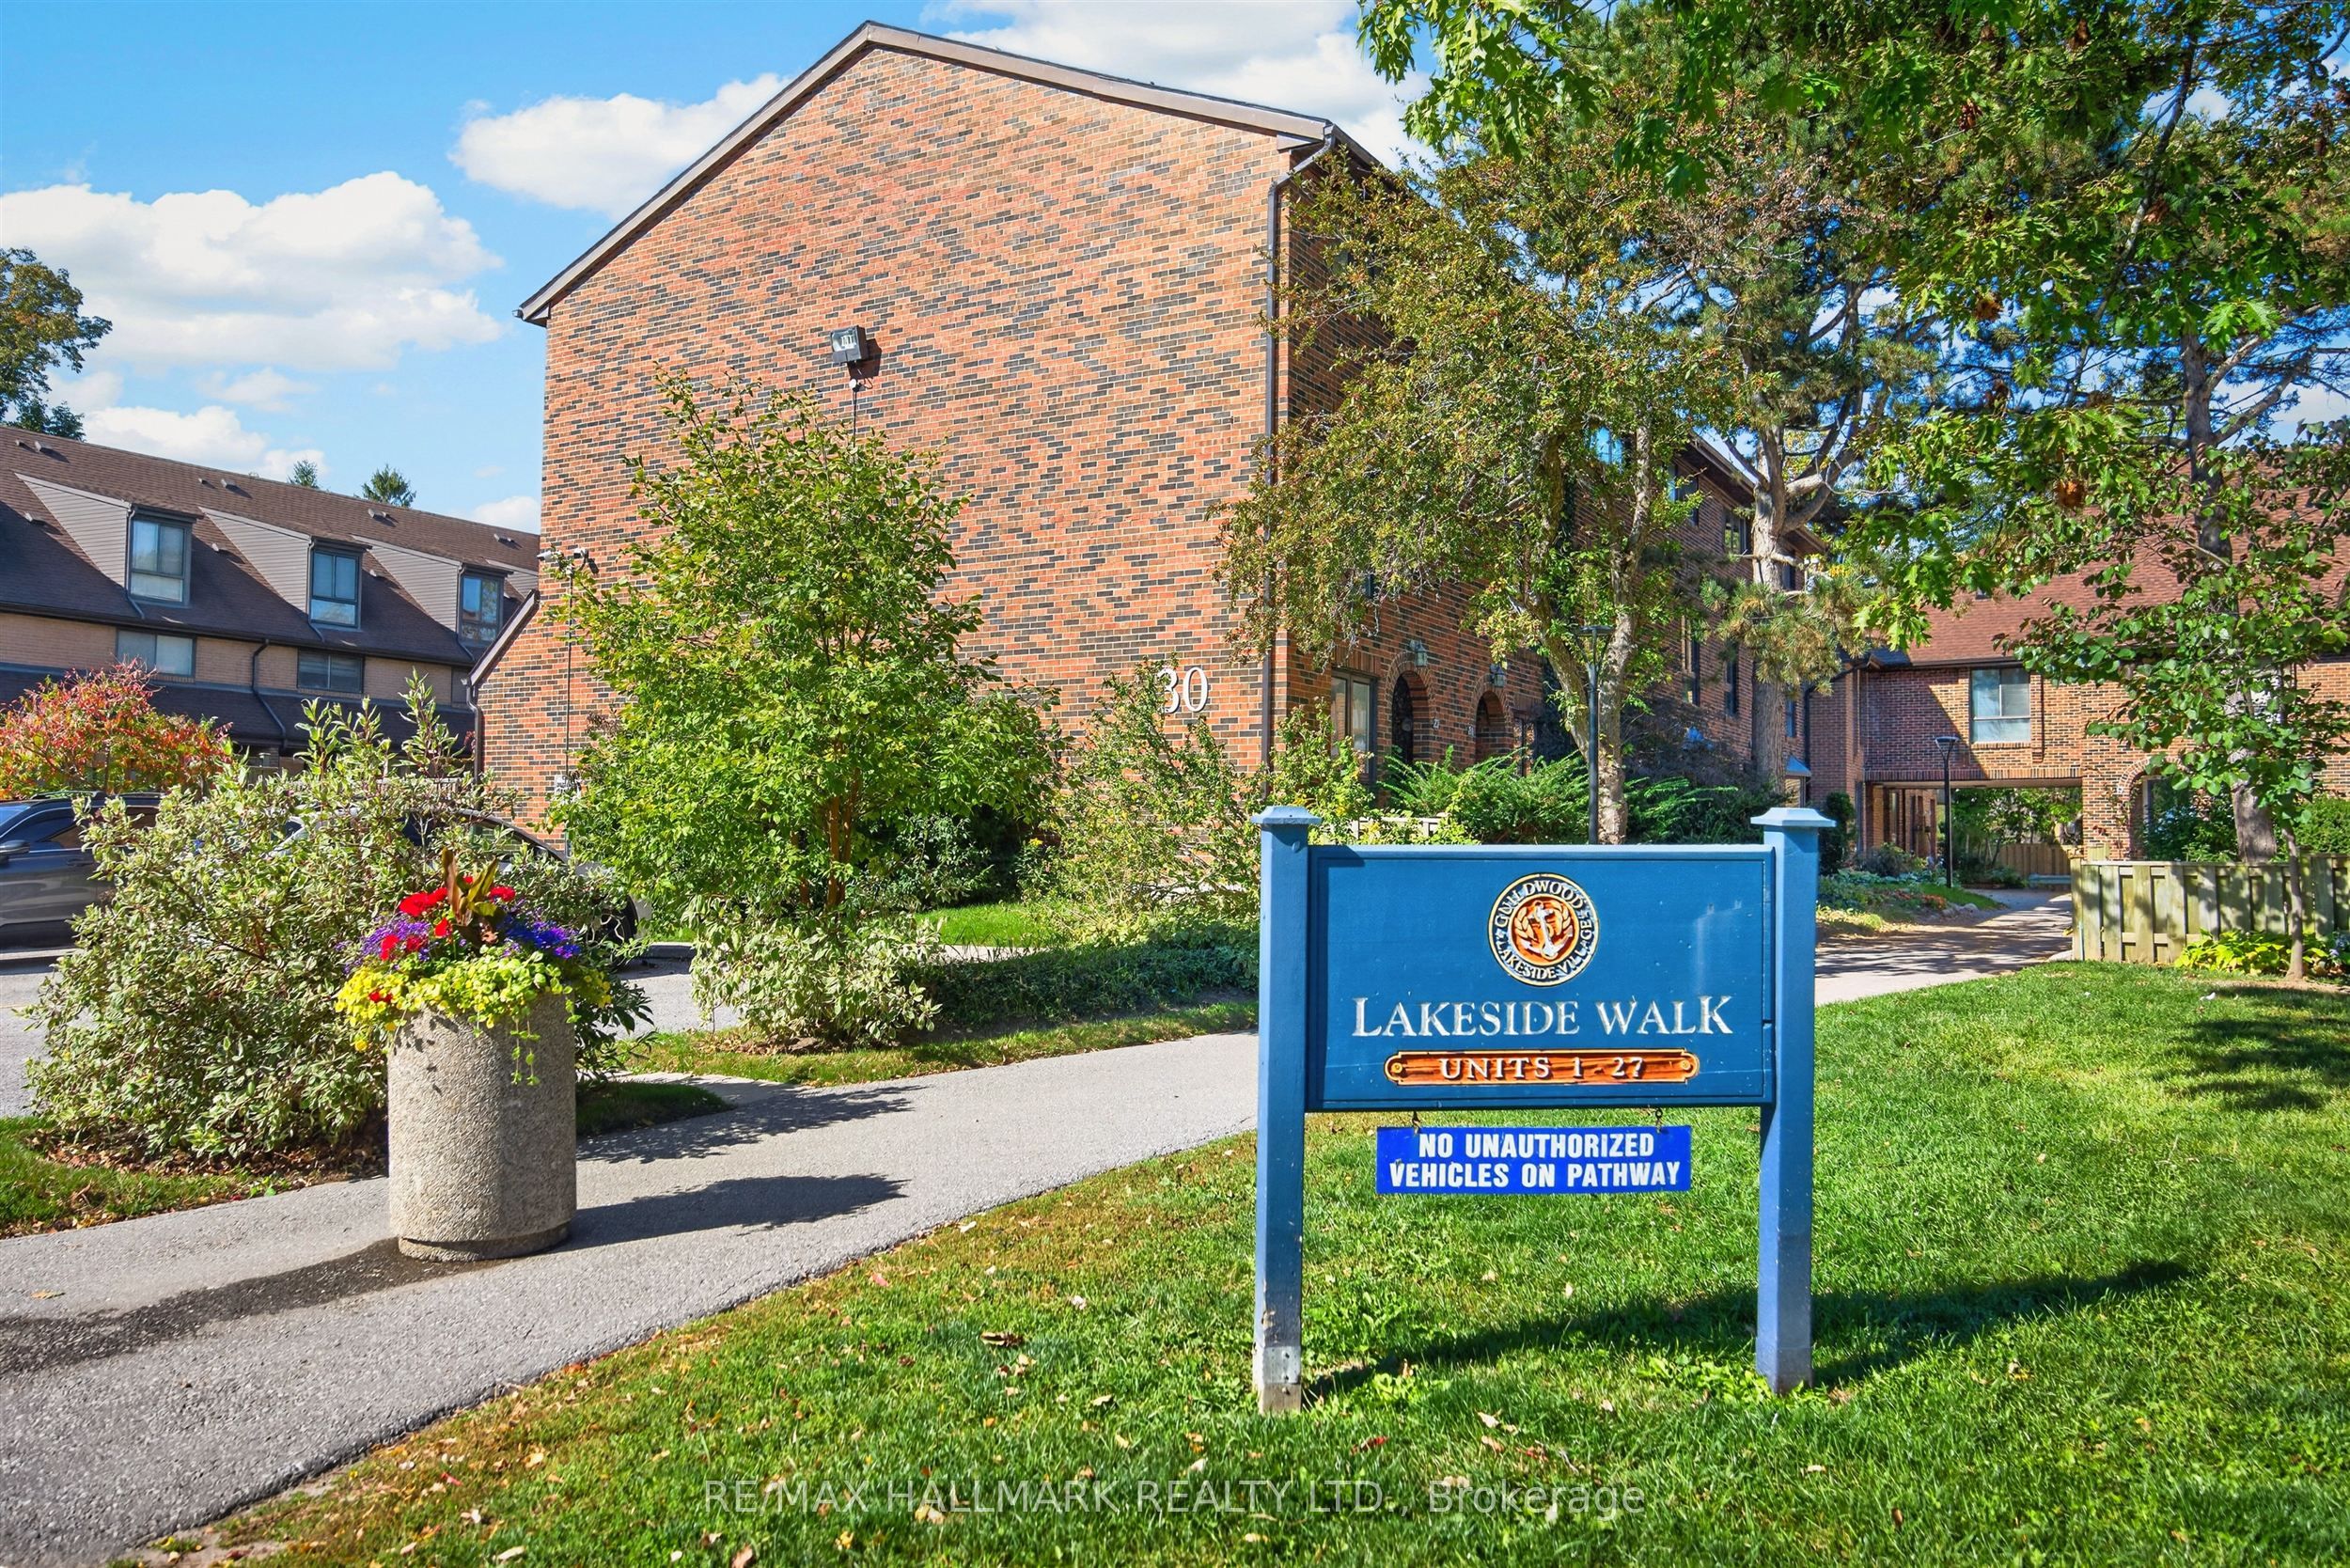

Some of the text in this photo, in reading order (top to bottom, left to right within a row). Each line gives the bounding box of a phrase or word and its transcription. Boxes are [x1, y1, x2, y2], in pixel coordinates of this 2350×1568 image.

[1155, 666, 1208, 713] 30
[1495, 880, 1584, 928] GUILDWOOD
[1496, 912, 1592, 980] LAKESIDE VILLAGE
[1353, 995, 1733, 1037] LAKESIDE WALK
[1438, 1057, 1550, 1079] UNITS
[1573, 1057, 1583, 1077] 1
[1612, 1057, 1644, 1078] 27
[1418, 1133, 1654, 1158] NO UNAUTHORIZED
[1389, 1161, 1681, 1188] VEHICLES ON PATHWAY
